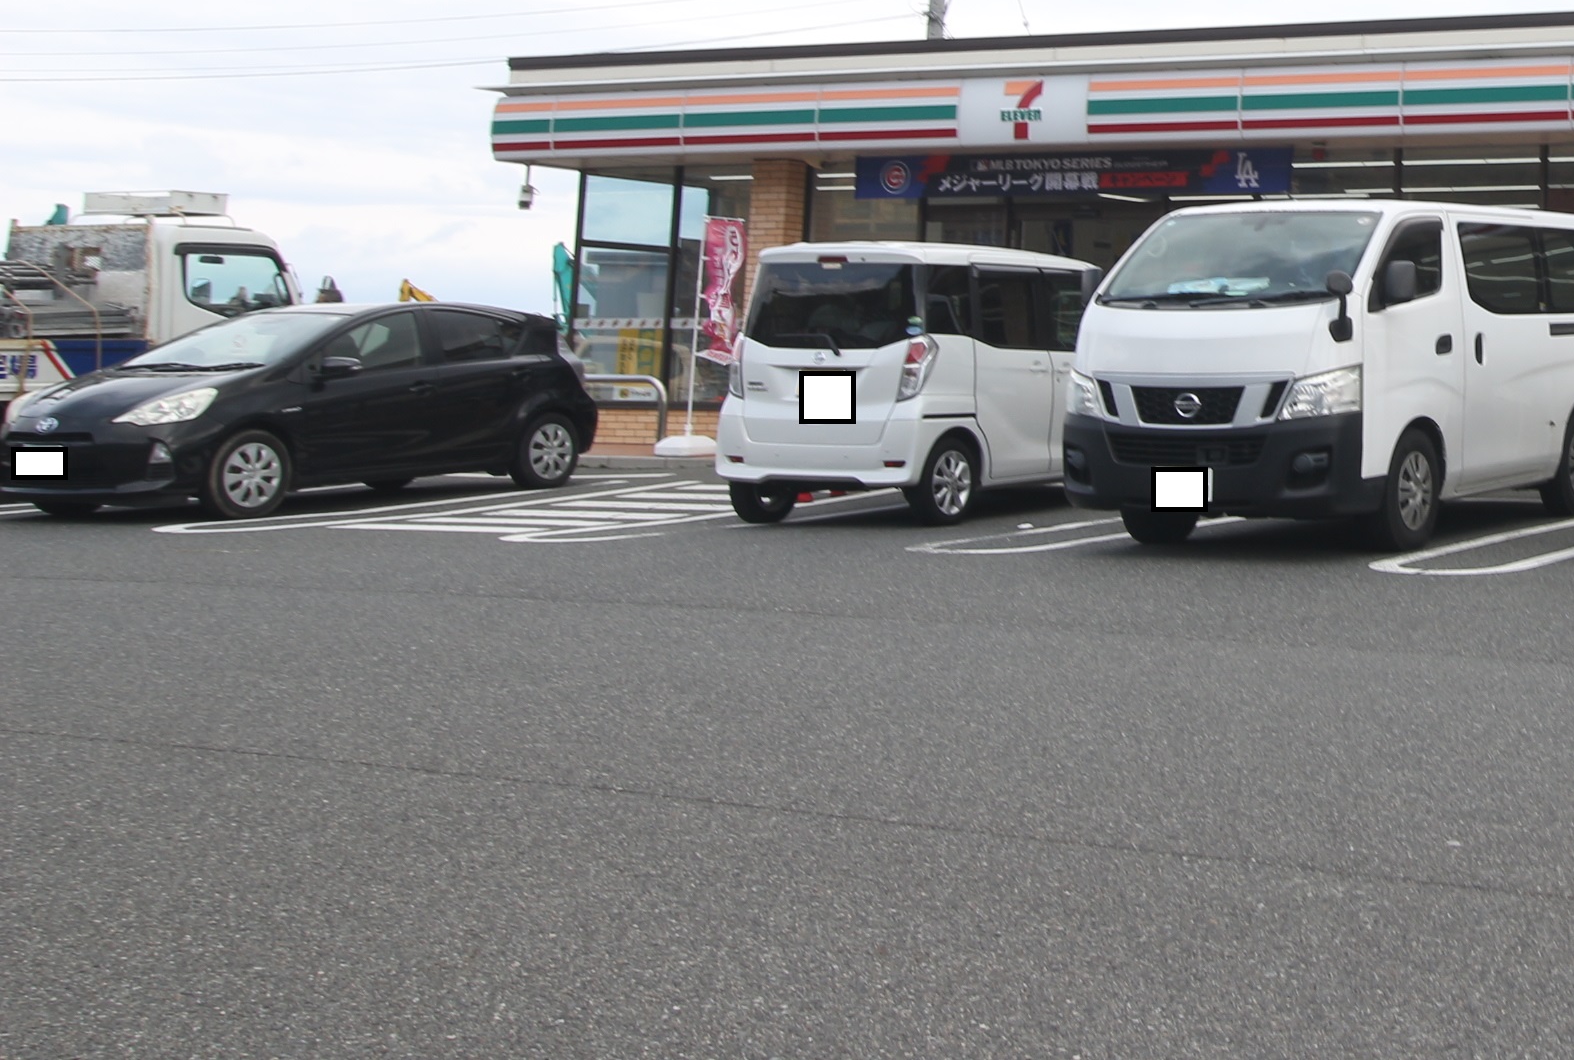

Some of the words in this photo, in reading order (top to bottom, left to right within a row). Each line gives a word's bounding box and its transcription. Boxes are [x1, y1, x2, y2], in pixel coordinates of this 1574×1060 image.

[1015, 158, 1061, 170] TOKYO
[1062, 156, 1113, 169] SERIES
[937, 171, 1100, 192] メジャーリーグ開幕戦
